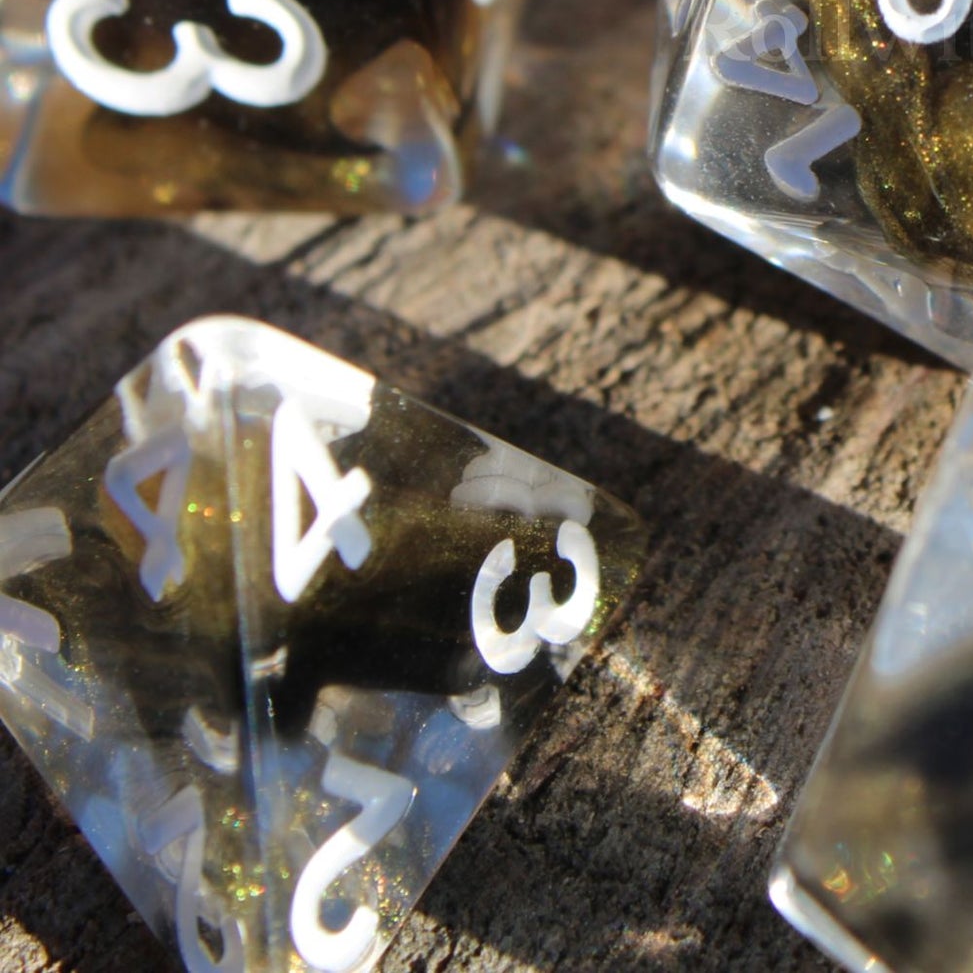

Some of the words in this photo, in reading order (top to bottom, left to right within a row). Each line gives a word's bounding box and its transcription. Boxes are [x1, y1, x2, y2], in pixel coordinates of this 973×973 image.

[271, 391, 373, 604] 4
[471, 520, 600, 674] 3
[290, 751, 416, 973] 2
